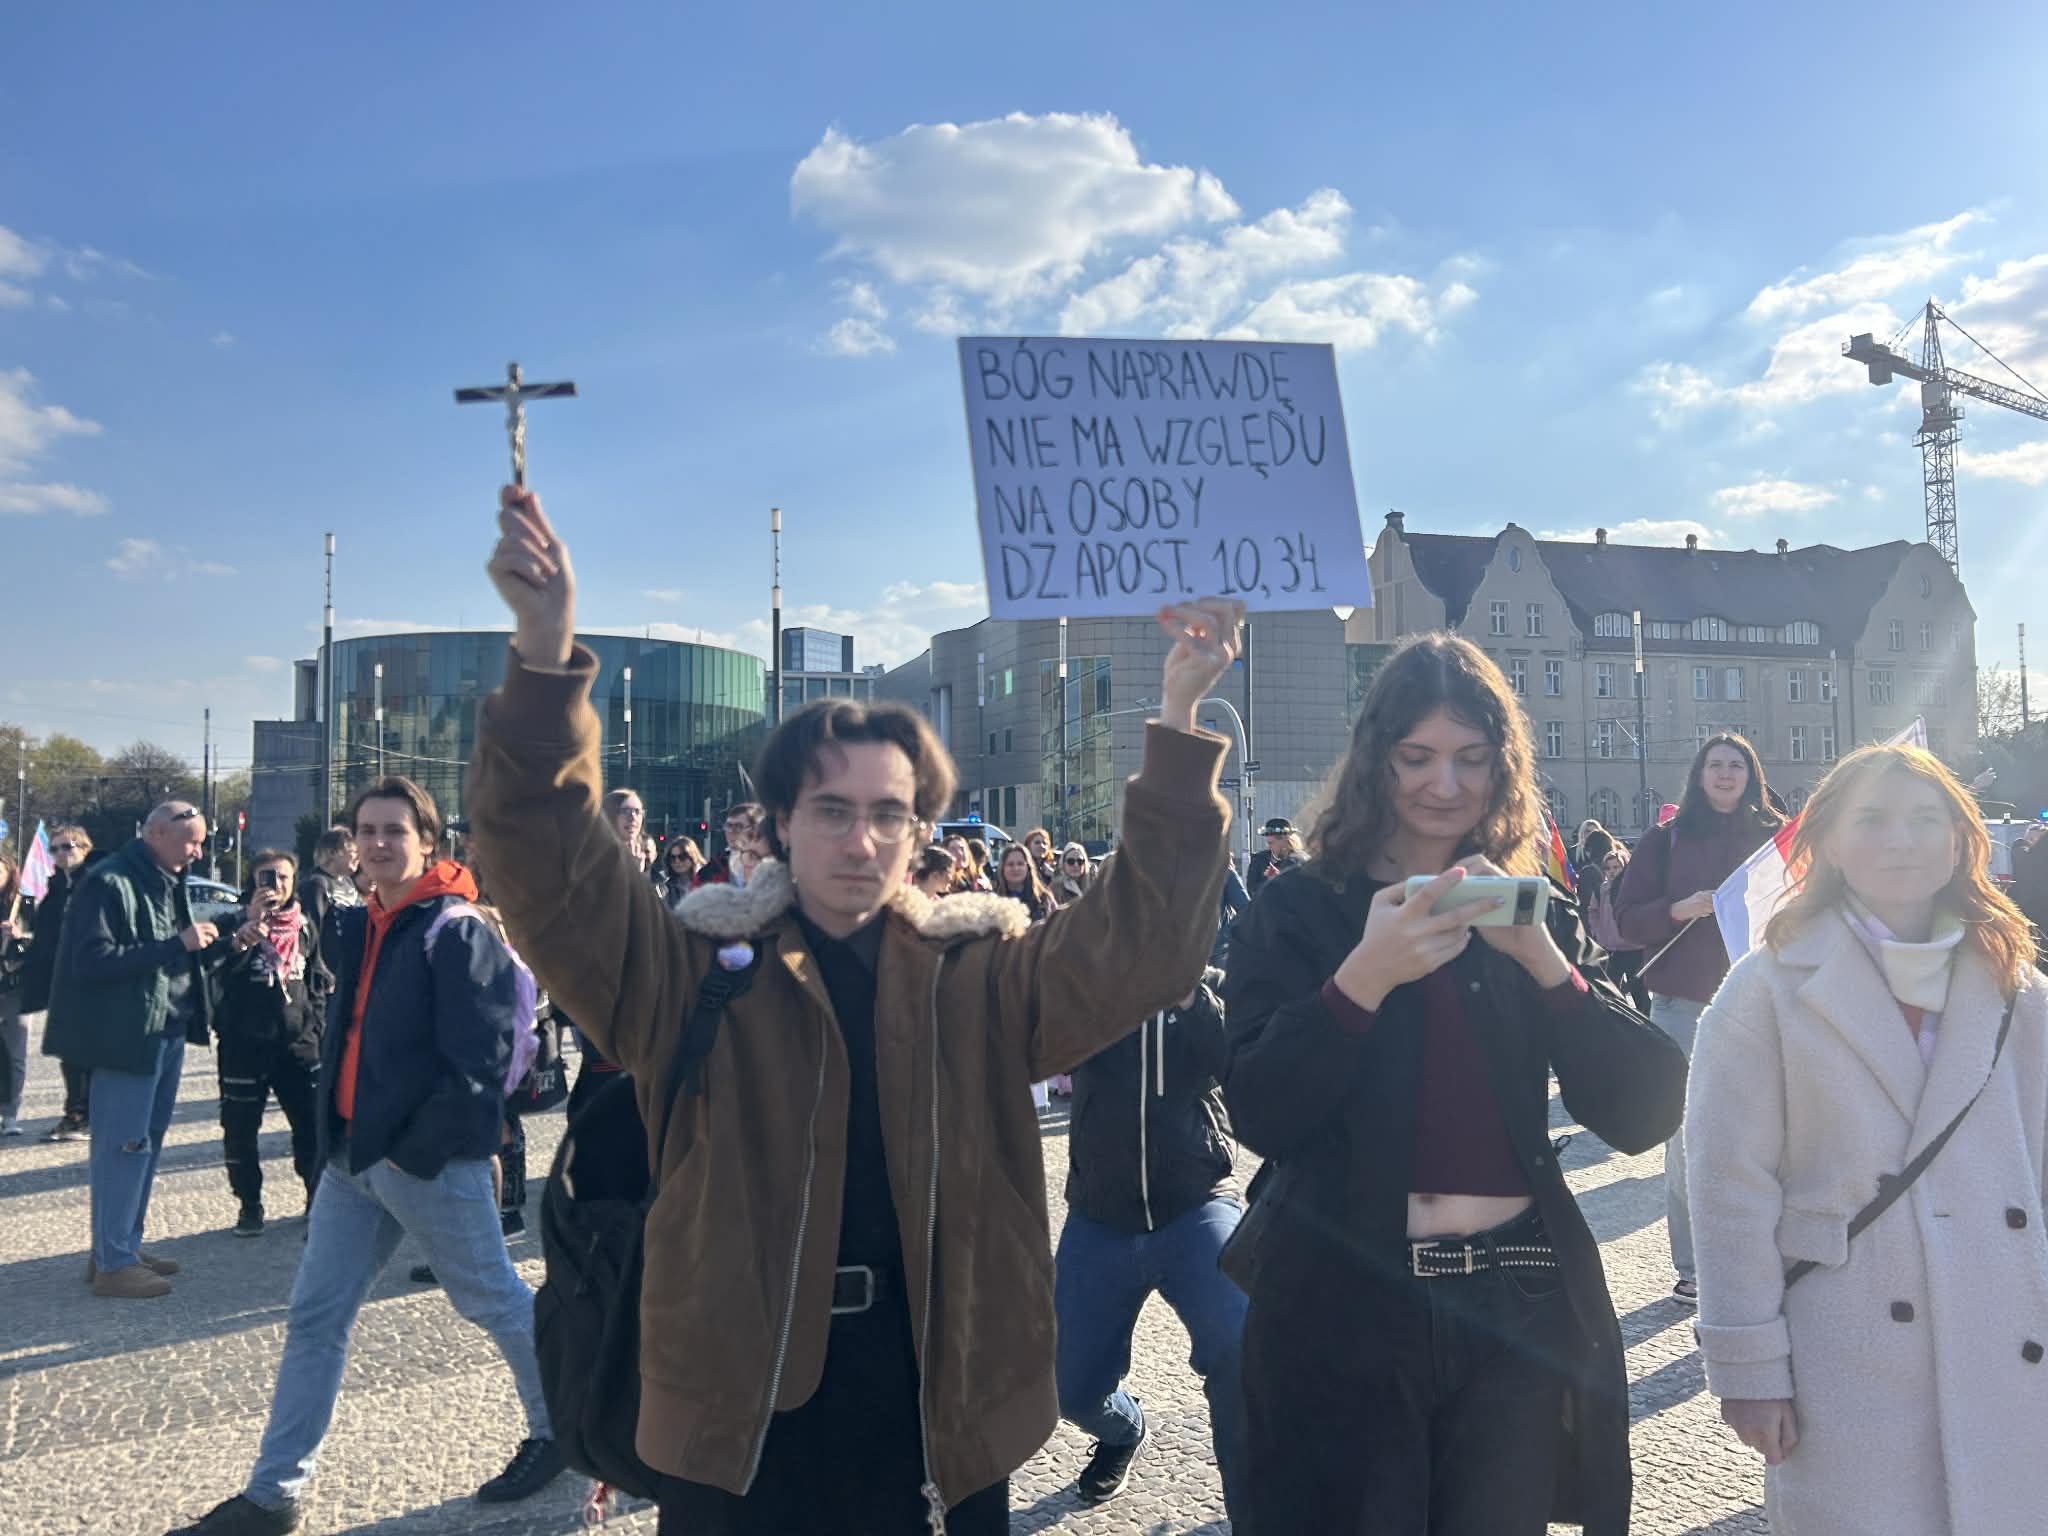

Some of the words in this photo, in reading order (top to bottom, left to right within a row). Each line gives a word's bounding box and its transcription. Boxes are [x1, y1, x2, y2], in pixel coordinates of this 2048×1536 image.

[977, 340, 1074, 401] BÓG
[1088, 350, 1295, 414] NAPRAWDĘ
[986, 415, 1057, 469] NIE
[1071, 415, 1125, 467] MA
[1135, 411, 1326, 479] WZGLĘDU
[994, 484, 1055, 535] NA
[1068, 476, 1204, 536] OSOBY
[1076, 539, 1193, 598] APOST.
